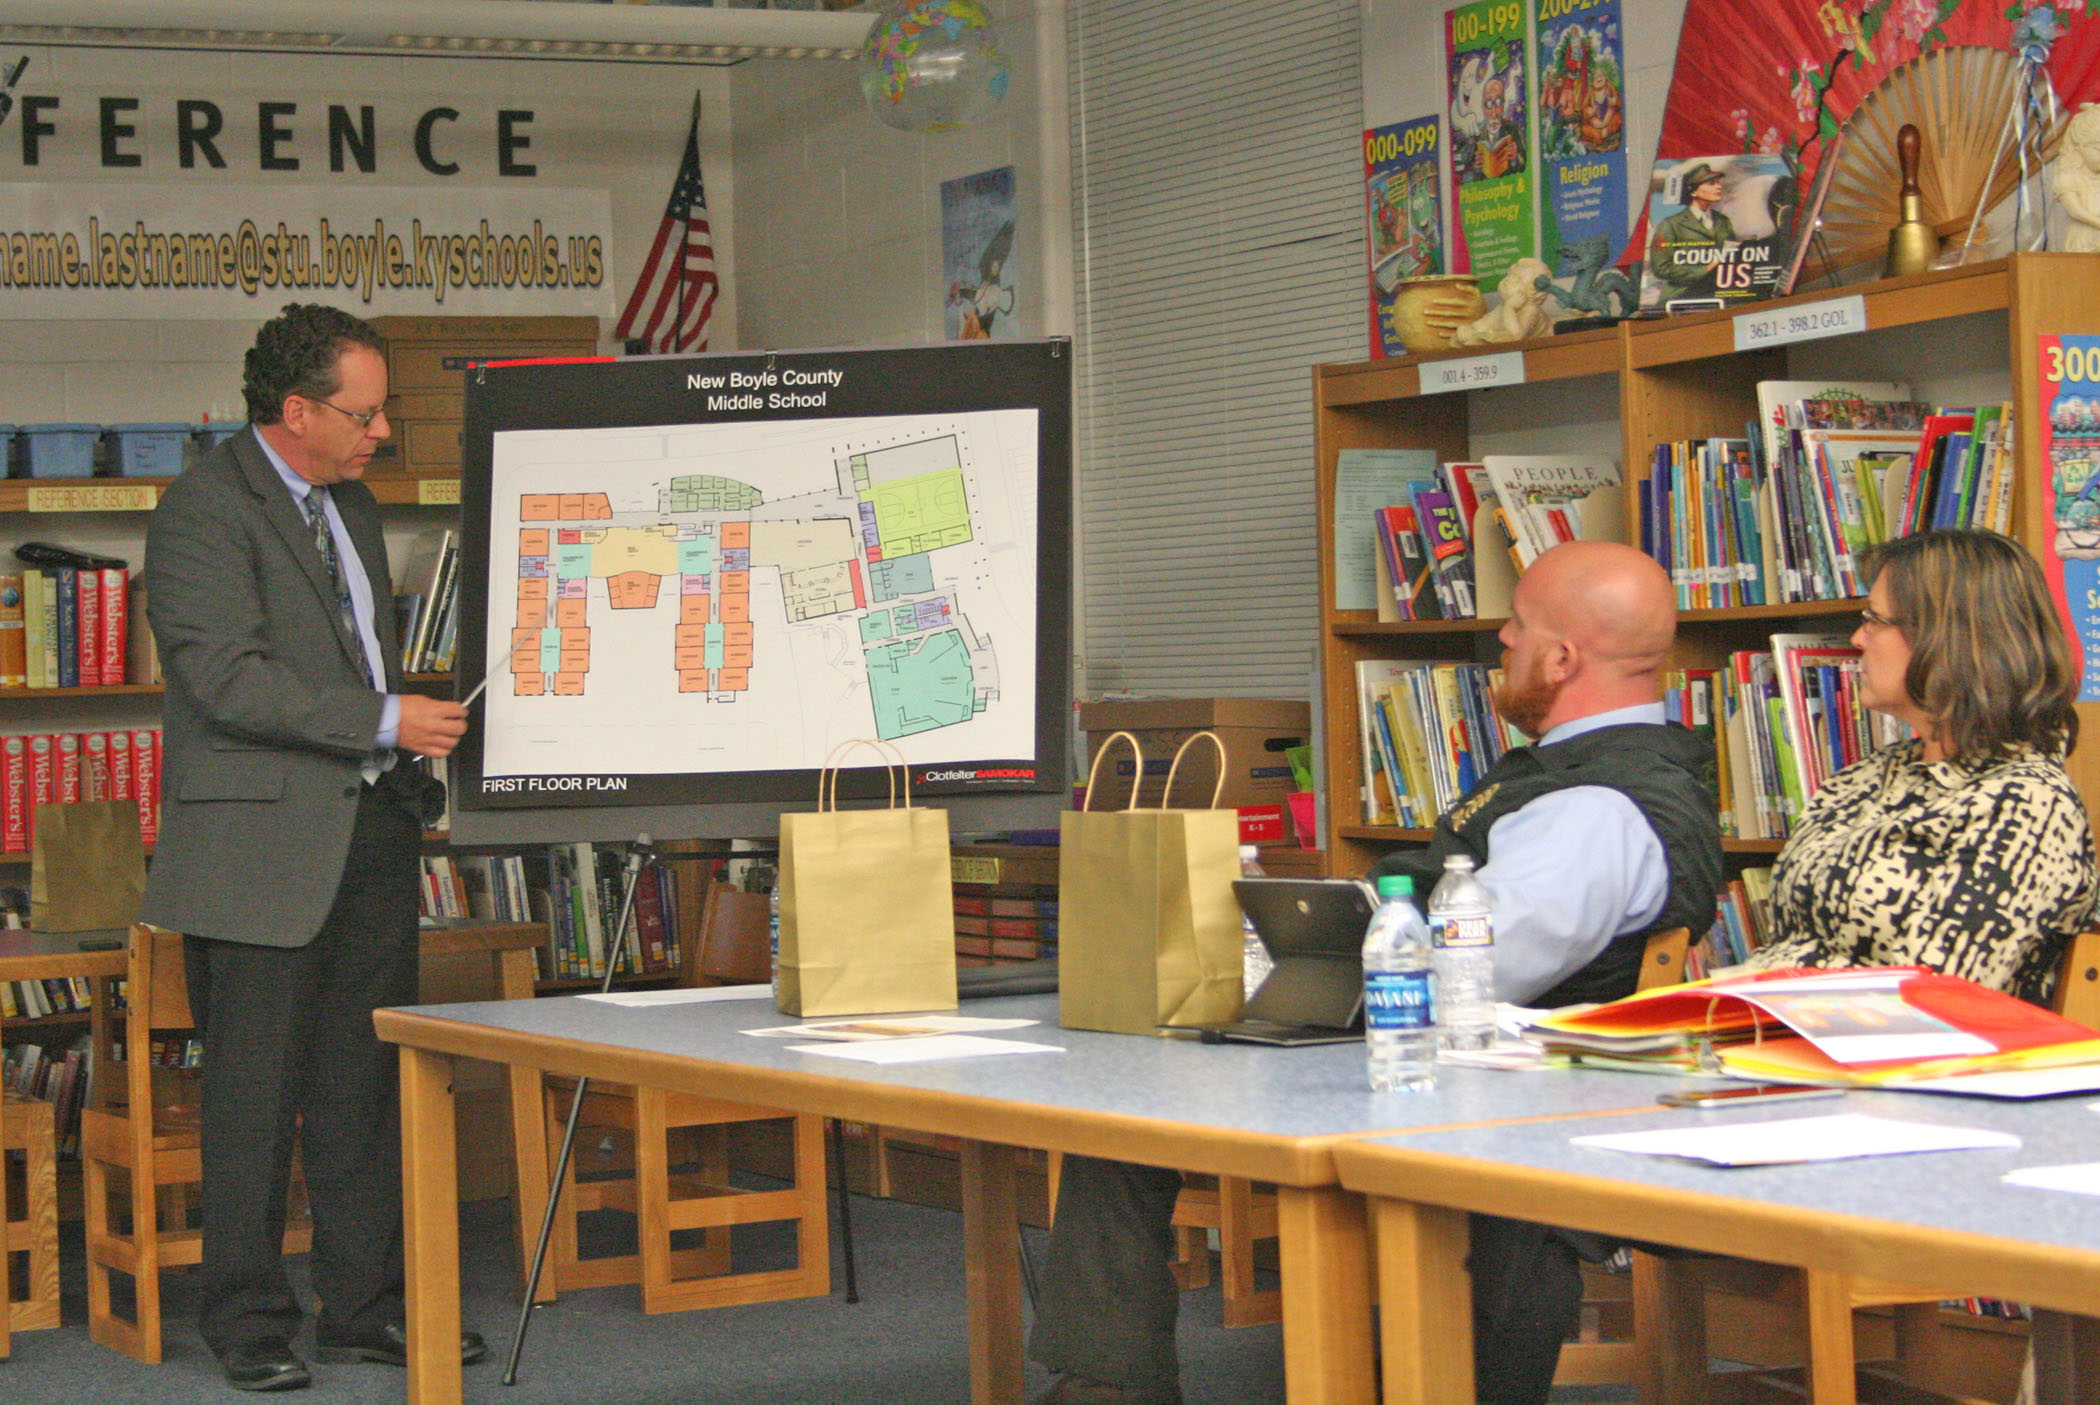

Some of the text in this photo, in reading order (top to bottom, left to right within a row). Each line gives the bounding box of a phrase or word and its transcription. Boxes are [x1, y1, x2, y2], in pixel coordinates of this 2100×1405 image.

[1453, 3, 1520, 45] 100-199
[21, 95, 538, 177] FERENCE
[1366, 124, 1437, 164] 000-099
[1560, 162, 1610, 186] Religion
[1460, 178, 1526, 203] Philosophy &
[1464, 204, 1520, 227] Psychology
[1673, 246, 1770, 265] COUNT ON
[1716, 263, 1752, 289] US
[1750, 322, 1778, 339] 362.1
[1789, 314, 1818, 333] 398.2
[1821, 310, 1848, 328] GOL
[687, 369, 843, 390] New Boyle County
[1443, 370, 1466, 384] 001.4
[1474, 365, 1498, 381] 359.9
[708, 391, 826, 411] Middle School
[1513, 466, 1599, 481] PEOPLE
[37, 488, 148, 508] REFERENCE SECTION
[83, 590, 98, 666] Webster's
[106, 588, 123, 665] Webster's
[35, 754, 50, 804] Webst
[138, 749, 154, 825] Webster's
[483, 777, 627, 793] FIRST FLOOR PLAN
[8, 755, 25, 833] Webster's
